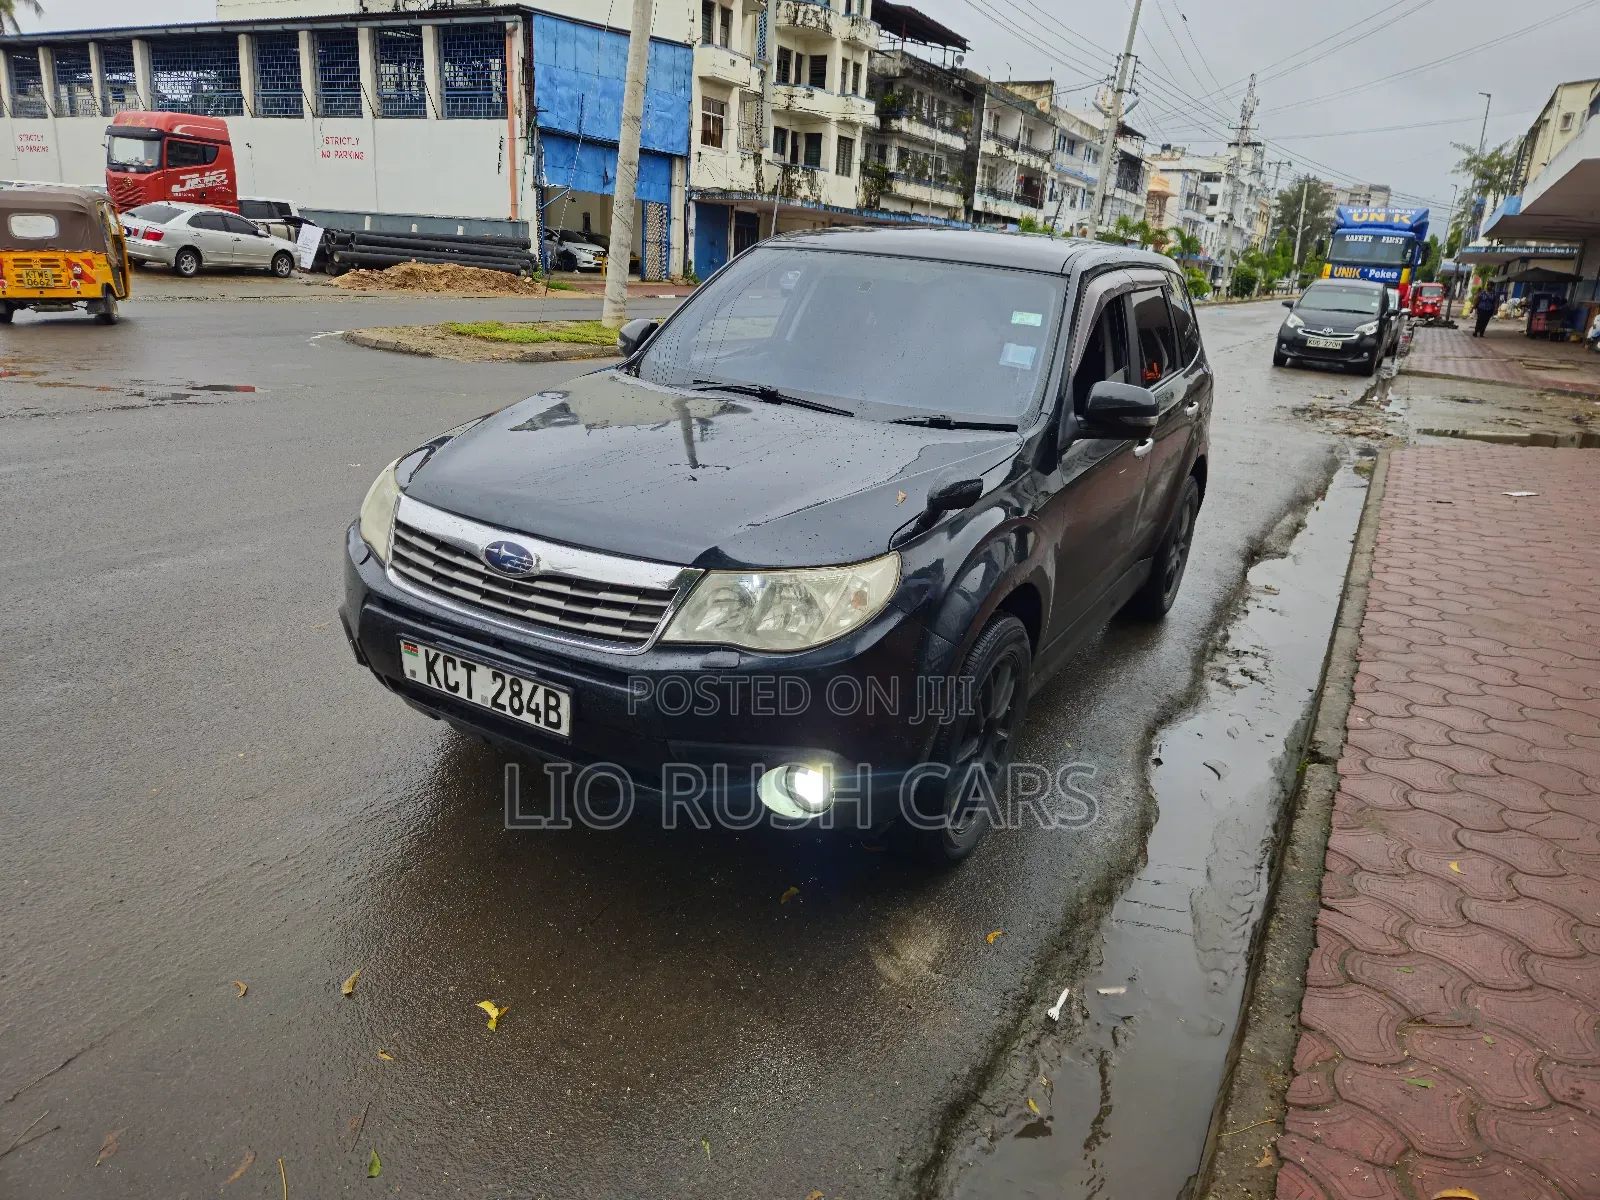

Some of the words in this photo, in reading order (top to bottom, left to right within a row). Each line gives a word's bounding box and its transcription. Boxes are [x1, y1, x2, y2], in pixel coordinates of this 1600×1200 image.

[19, 133, 44, 141] STRICTLY
[325, 136, 360, 146] STRICTLY
[16, 145, 25, 153] NO
[25, 145, 49, 153] PARKING
[321, 150, 331, 159] NO
[334, 150, 365, 160] PARKING
[1345, 234, 1374, 242] SAFETY
[1381, 235, 1405, 244] FIRST
[1333, 266, 1362, 279] UNIK
[1368, 268, 1398, 279] Pekee
[424, 649, 477, 700] KCT
[491, 671, 562, 730] 284B
